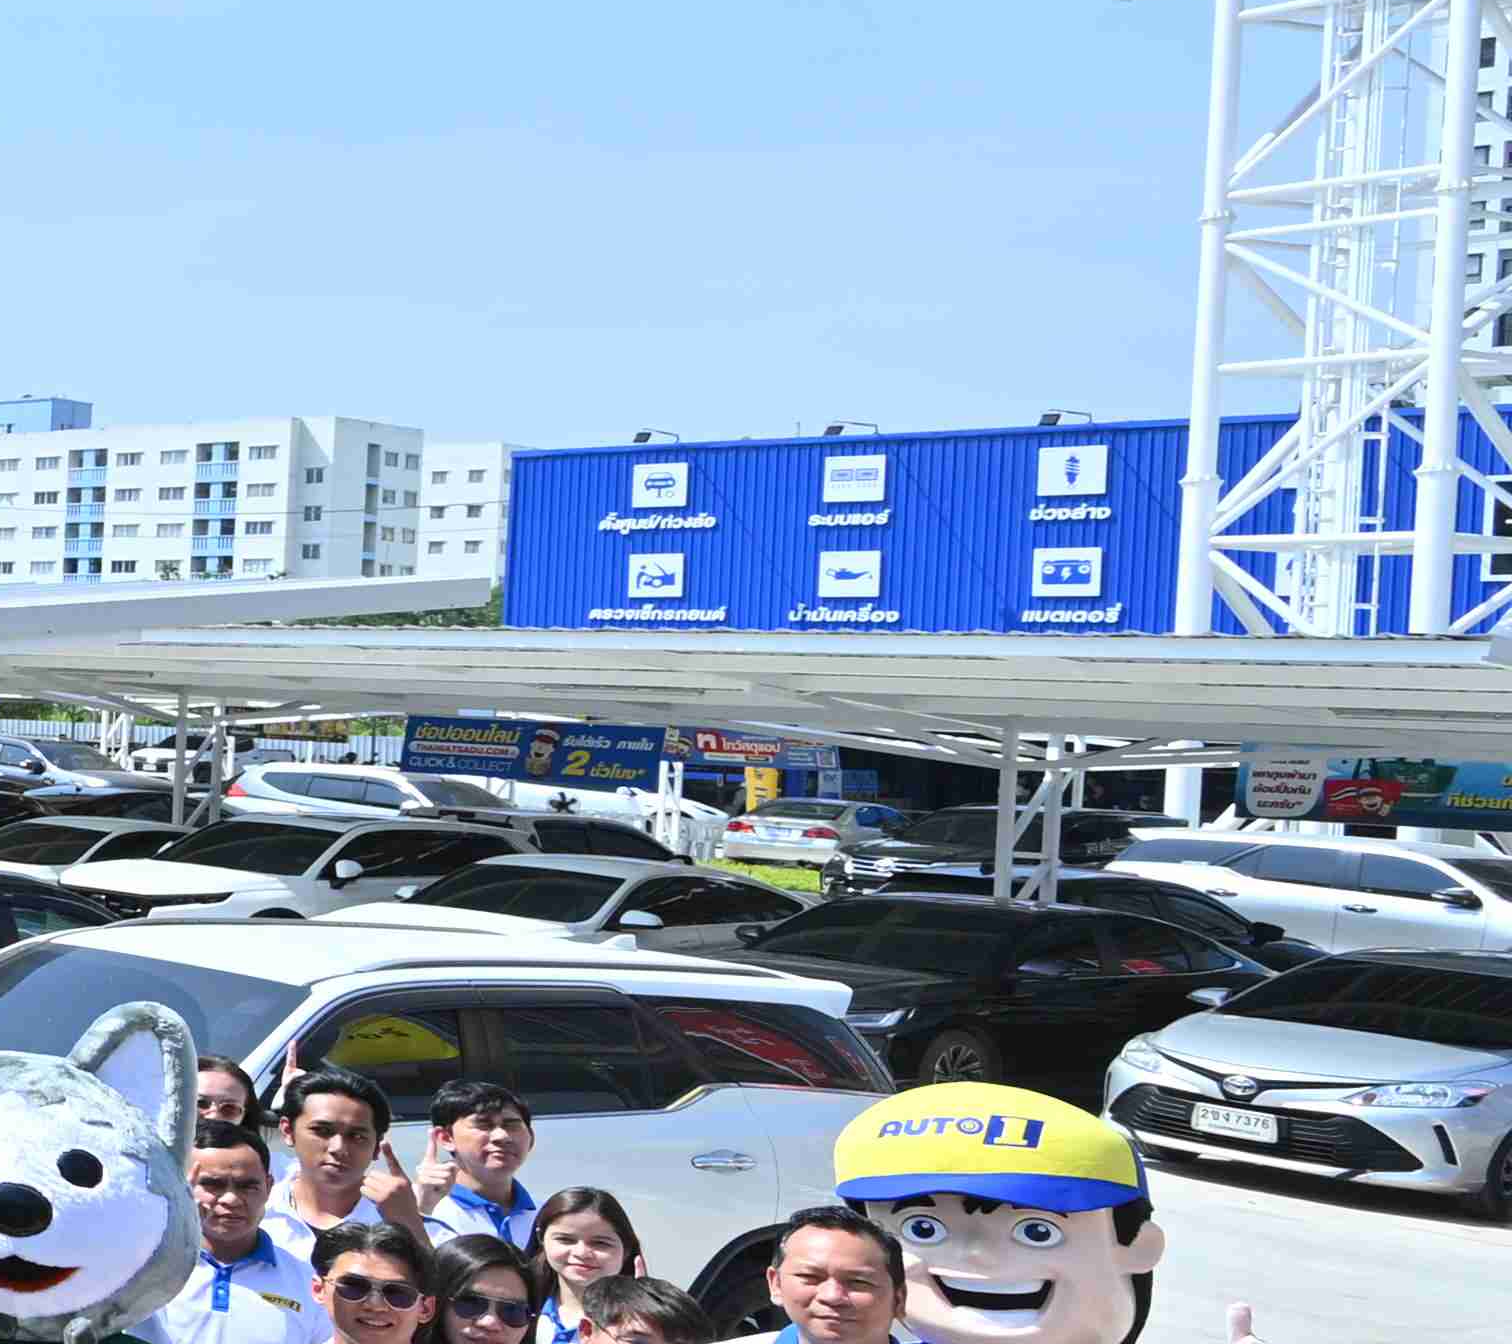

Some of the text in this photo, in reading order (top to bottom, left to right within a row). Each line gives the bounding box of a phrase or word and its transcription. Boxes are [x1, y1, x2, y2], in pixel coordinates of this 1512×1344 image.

[808, 509, 891, 527] ระบบแอร์
[1029, 504, 1112, 521] ช่วงล่าง
[788, 603, 900, 623] น้ำมันเครื่อง
[1021, 602, 1123, 624] แบตเตอรี่
[561, 750, 590, 776] 2
[1235, 1114, 1271, 1130] 7376
[877, 1114, 1045, 1151] AUTO1
